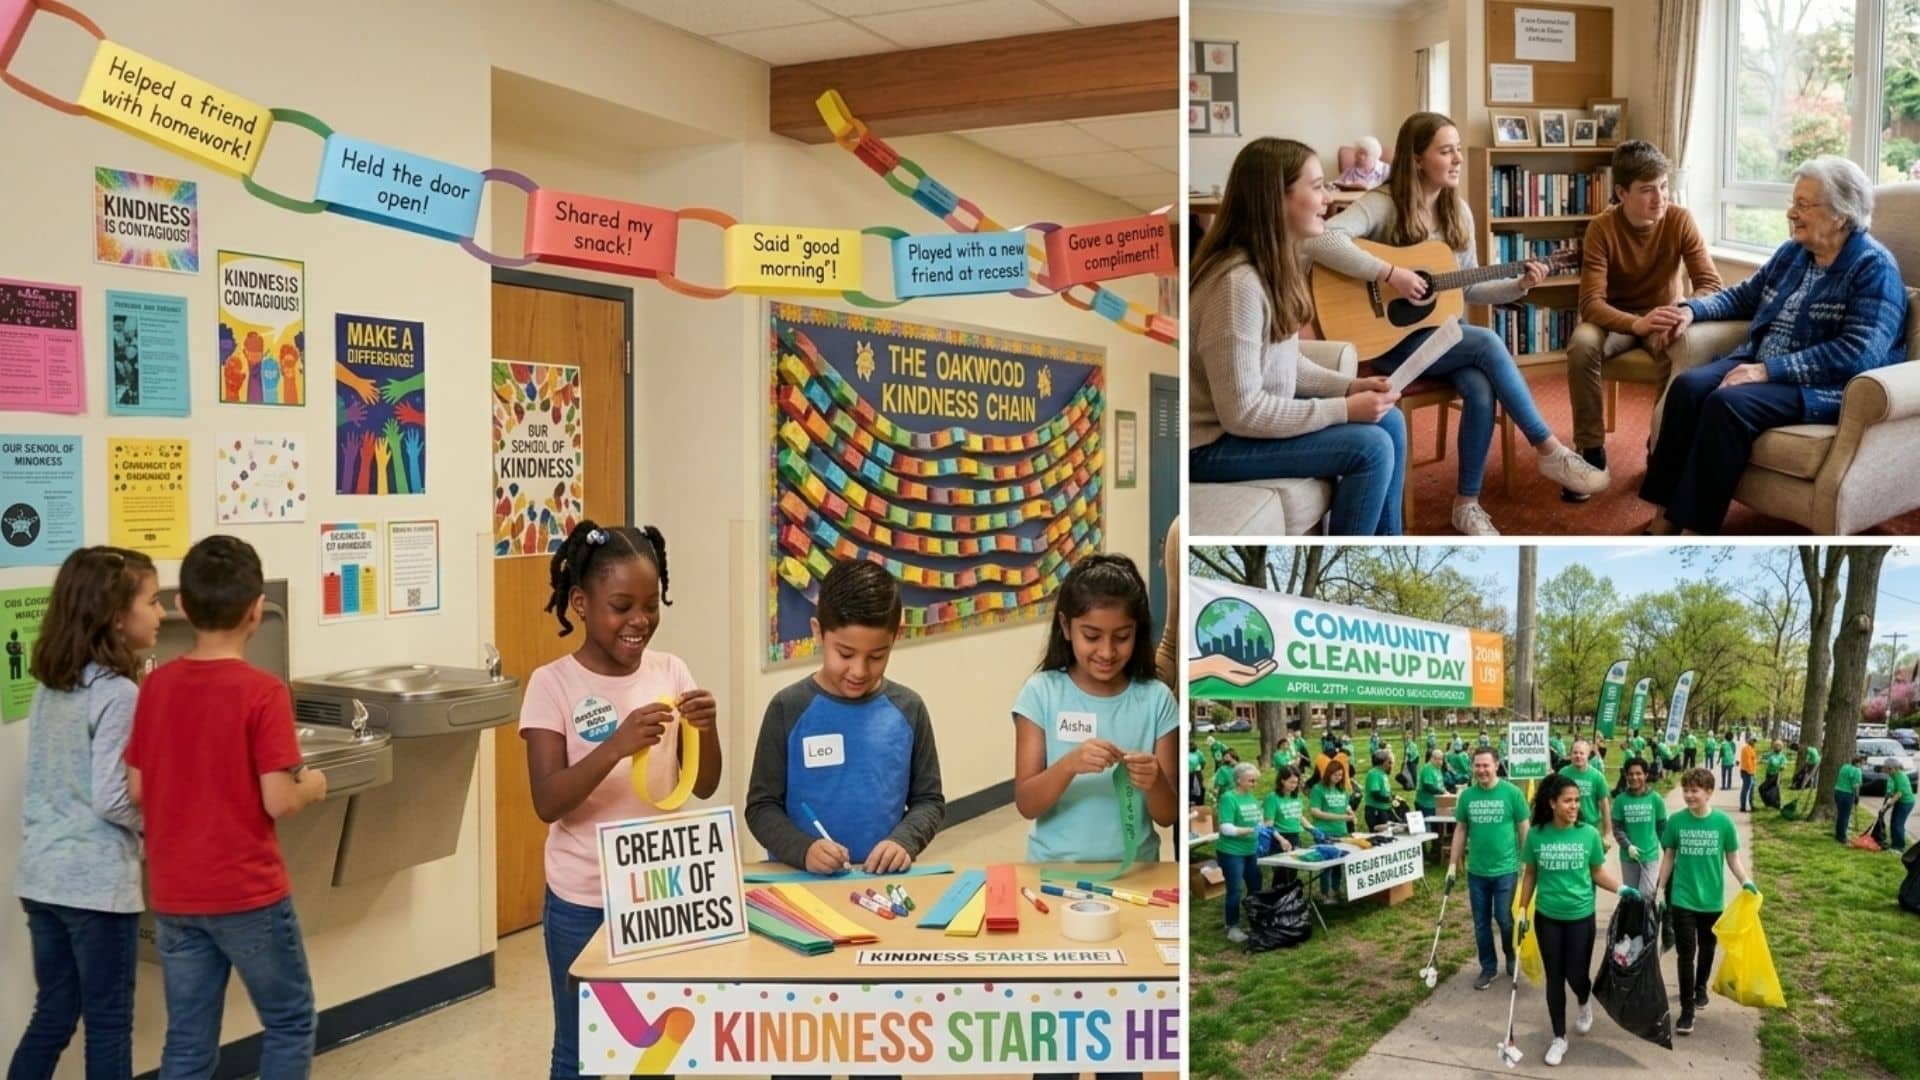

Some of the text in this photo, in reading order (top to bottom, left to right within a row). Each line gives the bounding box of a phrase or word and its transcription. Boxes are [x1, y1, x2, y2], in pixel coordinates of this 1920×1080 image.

[109, 56, 257, 135] Helped a friend
[101, 89, 251, 161] with homework!
[342, 148, 470, 199] Held the door
[103, 194, 191, 227] KINDNESS
[378, 188, 429, 215] open!
[104, 219, 116, 233] IS
[555, 201, 653, 240] Shared my
[574, 234, 632, 256] snack!
[753, 232, 840, 259] Said "good
[908, 242, 1024, 261] Played with a new
[1105, 233, 1114, 245] a
[1084, 242, 1159, 271] compliment!
[760, 260, 836, 283] morning"!
[911, 264, 1024, 282] friend at recess!
[224, 290, 300, 312] CONTAGIOUS!
[347, 321, 414, 351] MAKE A
[888, 344, 1025, 388] THE OAKWOOD
[882, 383, 1036, 422] KINDNESS CHAIN
[552, 440, 565, 454] OF
[501, 457, 574, 478] KINDNESS
[1294, 609, 1450, 654] COMMUNITY
[1287, 641, 1421, 677] CLEAN-UP
[1427, 658, 1465, 681] DAY
[1286, 681, 1320, 694] APRIL
[1322, 683, 1348, 694] 27TH
[1059, 718, 1093, 734] Aisha
[808, 743, 833, 758] Leo
[615, 822, 723, 867] CREATE A
[629, 861, 716, 904] LINK OF
[620, 895, 734, 945] KINDNESS
[870, 951, 1111, 962] KINDNESS STARTS HERE!
[714, 1009, 1179, 1063] KINDNESS STARTS HE
